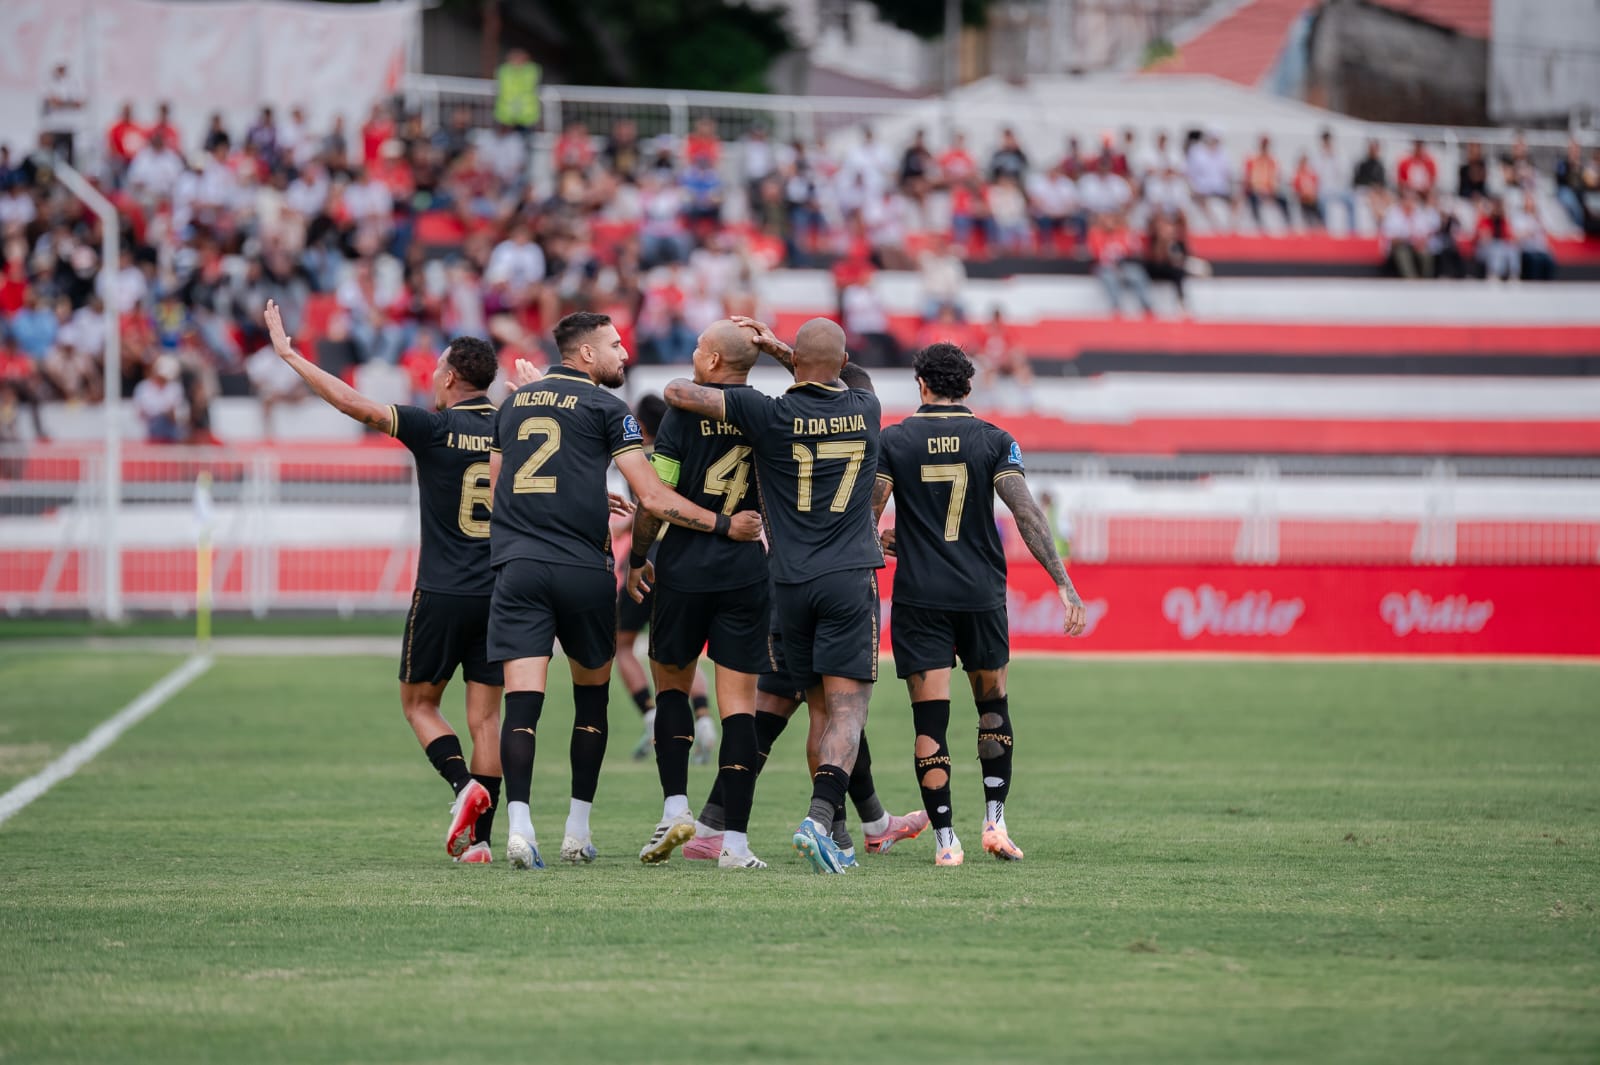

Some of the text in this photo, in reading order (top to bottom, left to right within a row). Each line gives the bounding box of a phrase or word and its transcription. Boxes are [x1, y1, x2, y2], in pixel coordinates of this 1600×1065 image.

[512, 390, 579, 410] NILSON JR
[829, 414, 867, 434] SILVA
[447, 432, 494, 452] I. INOC
[700, 420, 744, 436] G. FRA
[927, 436, 960, 454] CIRO
[513, 416, 562, 494] 2
[703, 444, 752, 516] 4
[792, 440, 867, 512] 17
[458, 462, 491, 538] 6
[920, 463, 968, 542] 7
[1006, 587, 1109, 637] idio
[1162, 584, 1305, 640] Vidio
[1380, 589, 1494, 637] Vidio
